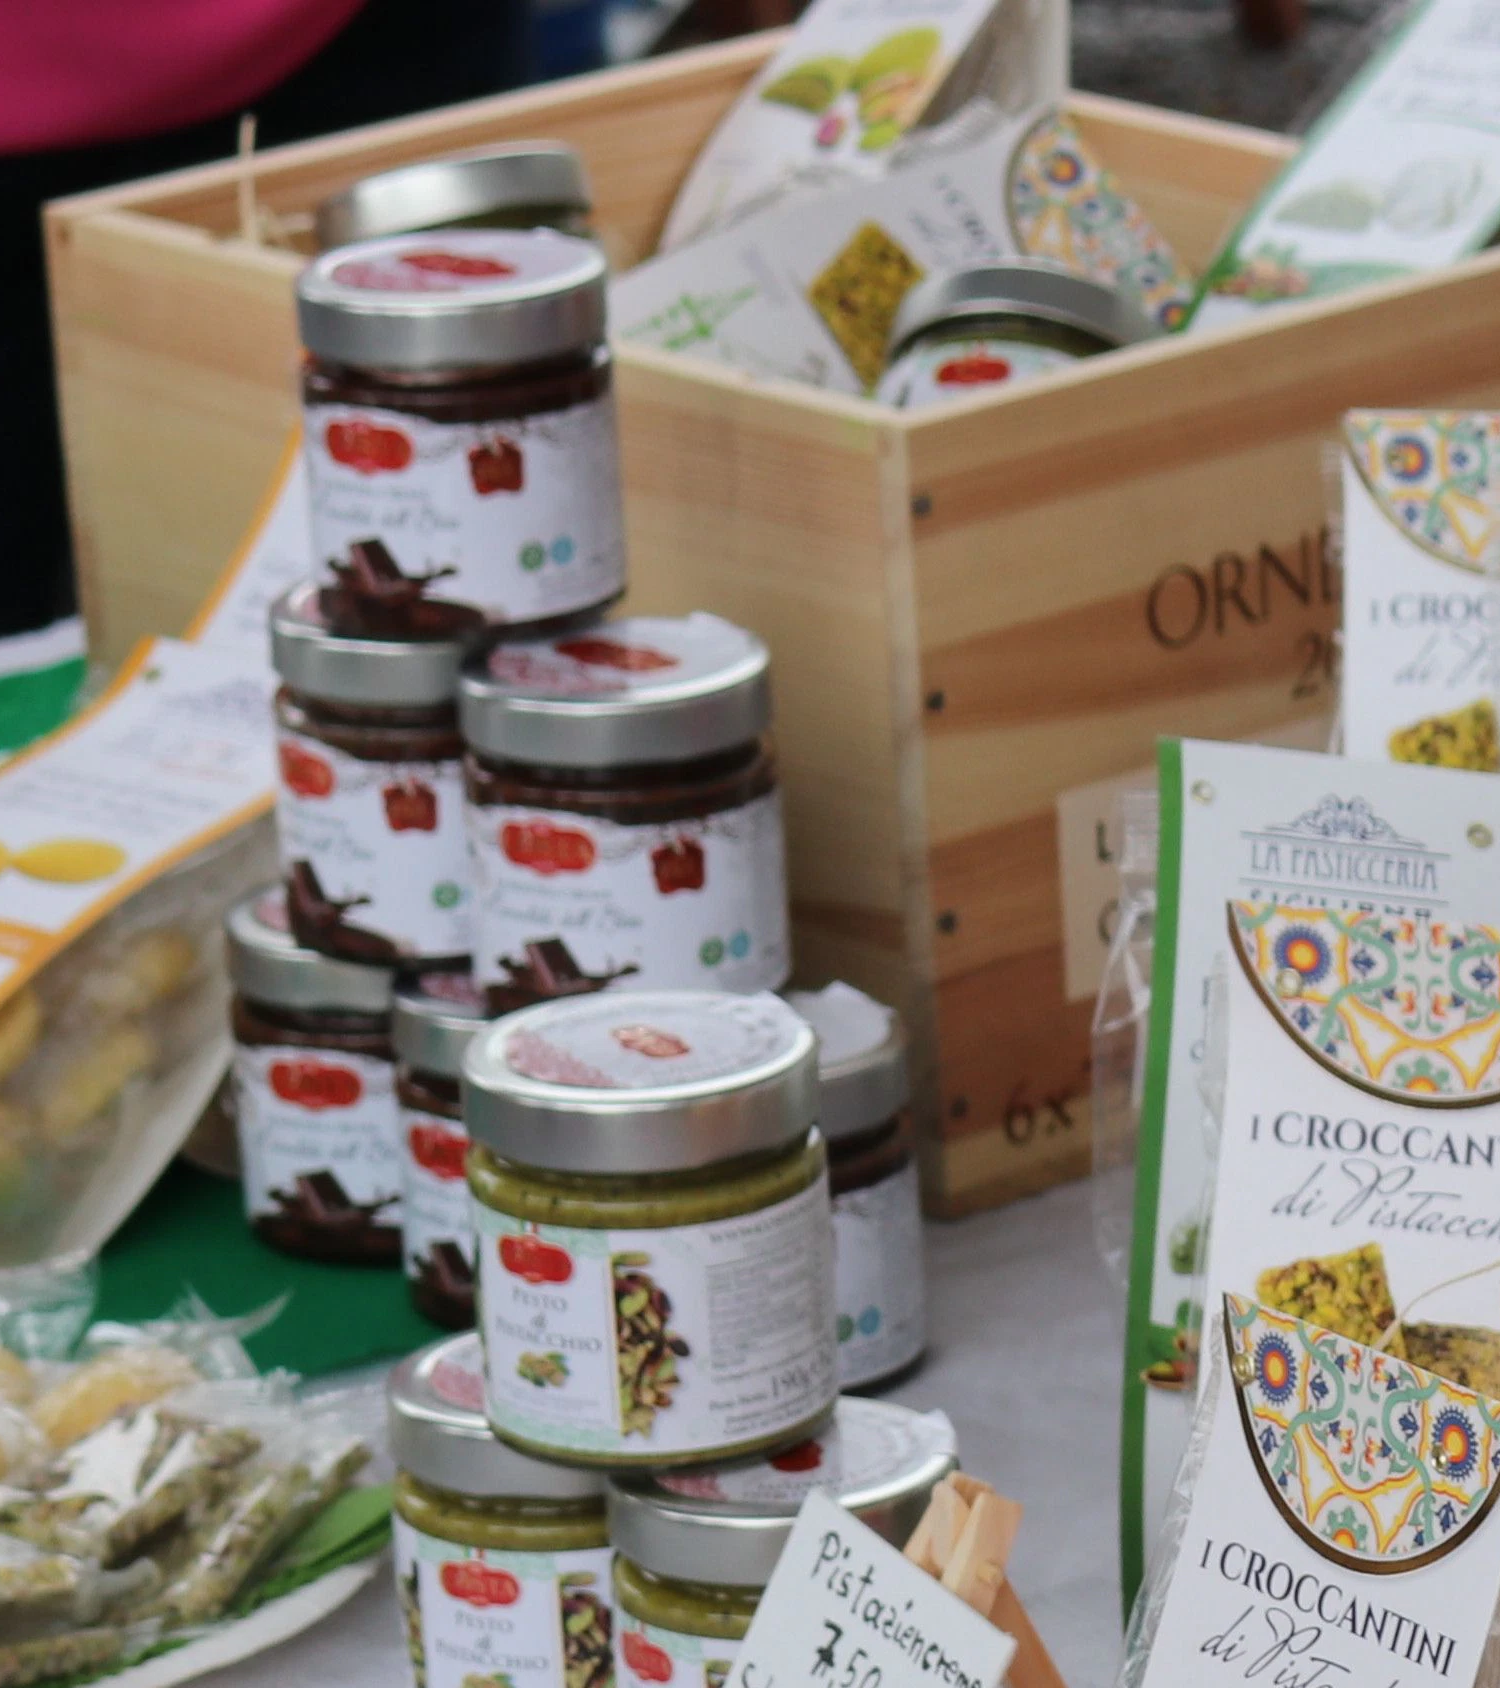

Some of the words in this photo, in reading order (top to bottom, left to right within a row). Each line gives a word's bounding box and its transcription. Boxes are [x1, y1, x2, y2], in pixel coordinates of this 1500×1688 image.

[1250, 840, 1279, 875] LA
[1288, 843, 1440, 892] PASTICCERIA
[1249, 1115, 1259, 1142] I
[1271, 1159, 1329, 1219] di
[1198, 1540, 1213, 1569] I
[1219, 1541, 1458, 1678] CROCCANTINI
[1200, 1604, 1250, 1665] di
